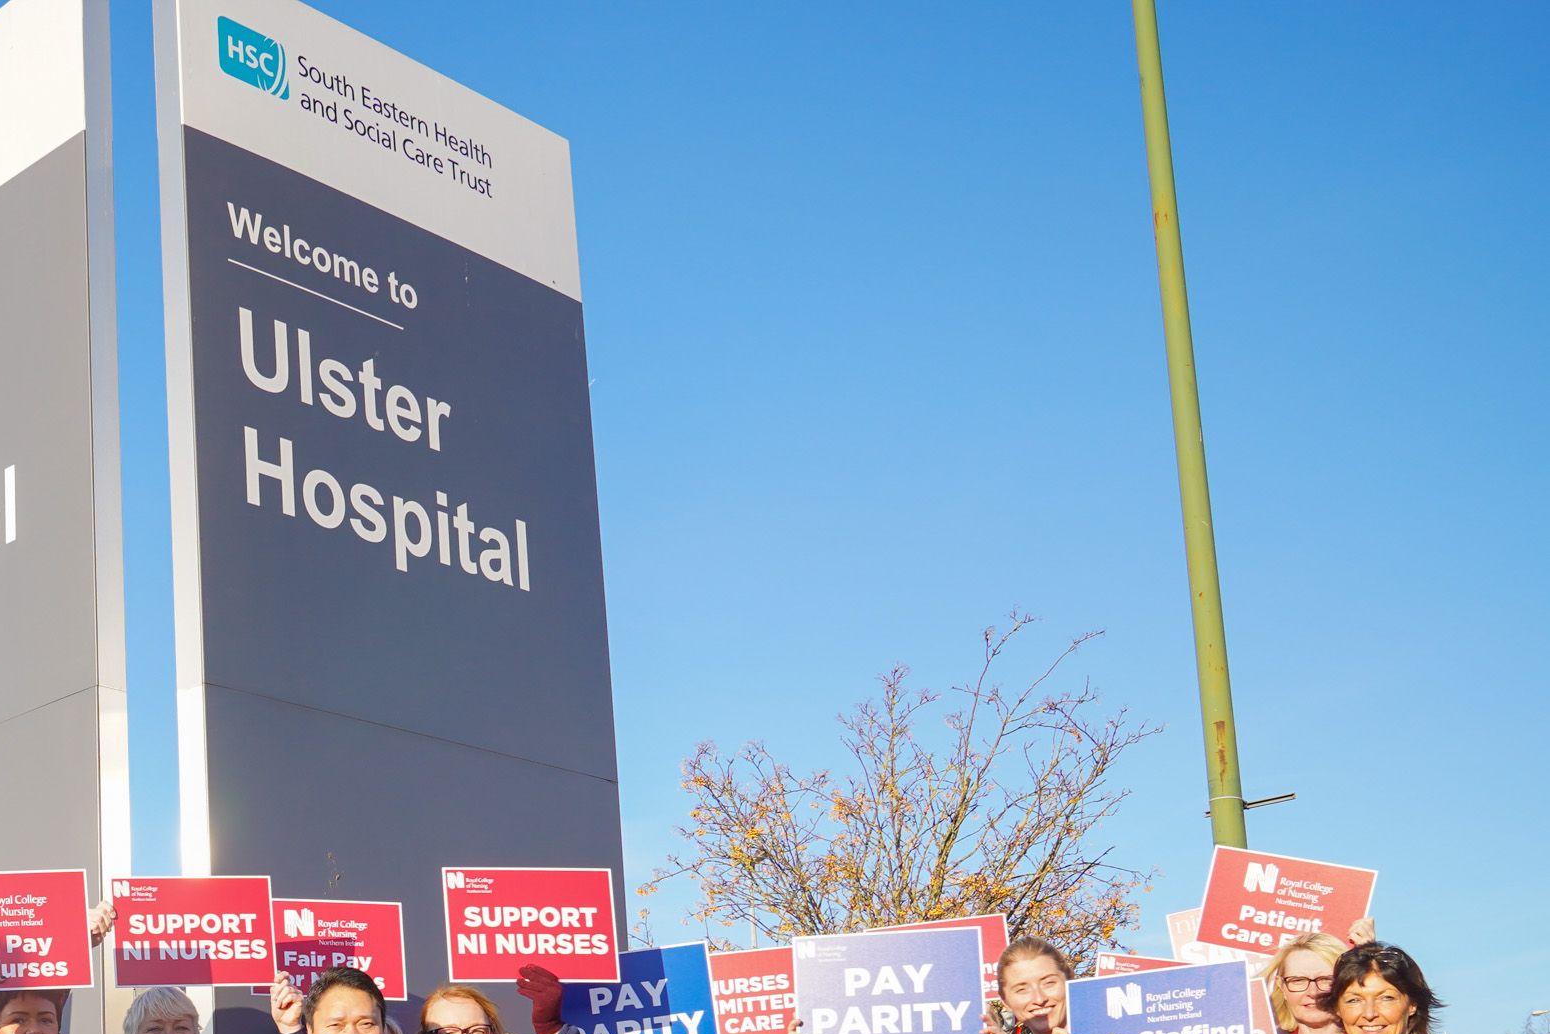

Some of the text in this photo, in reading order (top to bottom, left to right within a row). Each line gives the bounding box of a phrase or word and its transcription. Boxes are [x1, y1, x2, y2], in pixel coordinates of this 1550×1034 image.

[227, 34, 274, 77] HSC
[298, 56, 492, 169] South Eastern Health
[300, 92, 492, 199] and Social Care Trust
[227, 201, 417, 308] Welcome to
[239, 306, 451, 451] Ulster
[243, 425, 530, 592] Hospital
[129, 913, 256, 934] SUPPORT
[464, 907, 597, 928] SUPPORT
[1239, 905, 1322, 933] Patient
[6, 935, 53, 956] Pay
[457, 934, 608, 955] NI NURSES
[1221, 923, 1273, 946] Care
[122, 939, 267, 961] NI NURSES
[844, 964, 933, 996] PAY
[589, 978, 668, 1015] PAY
[725, 1014, 784, 1034] CARE
